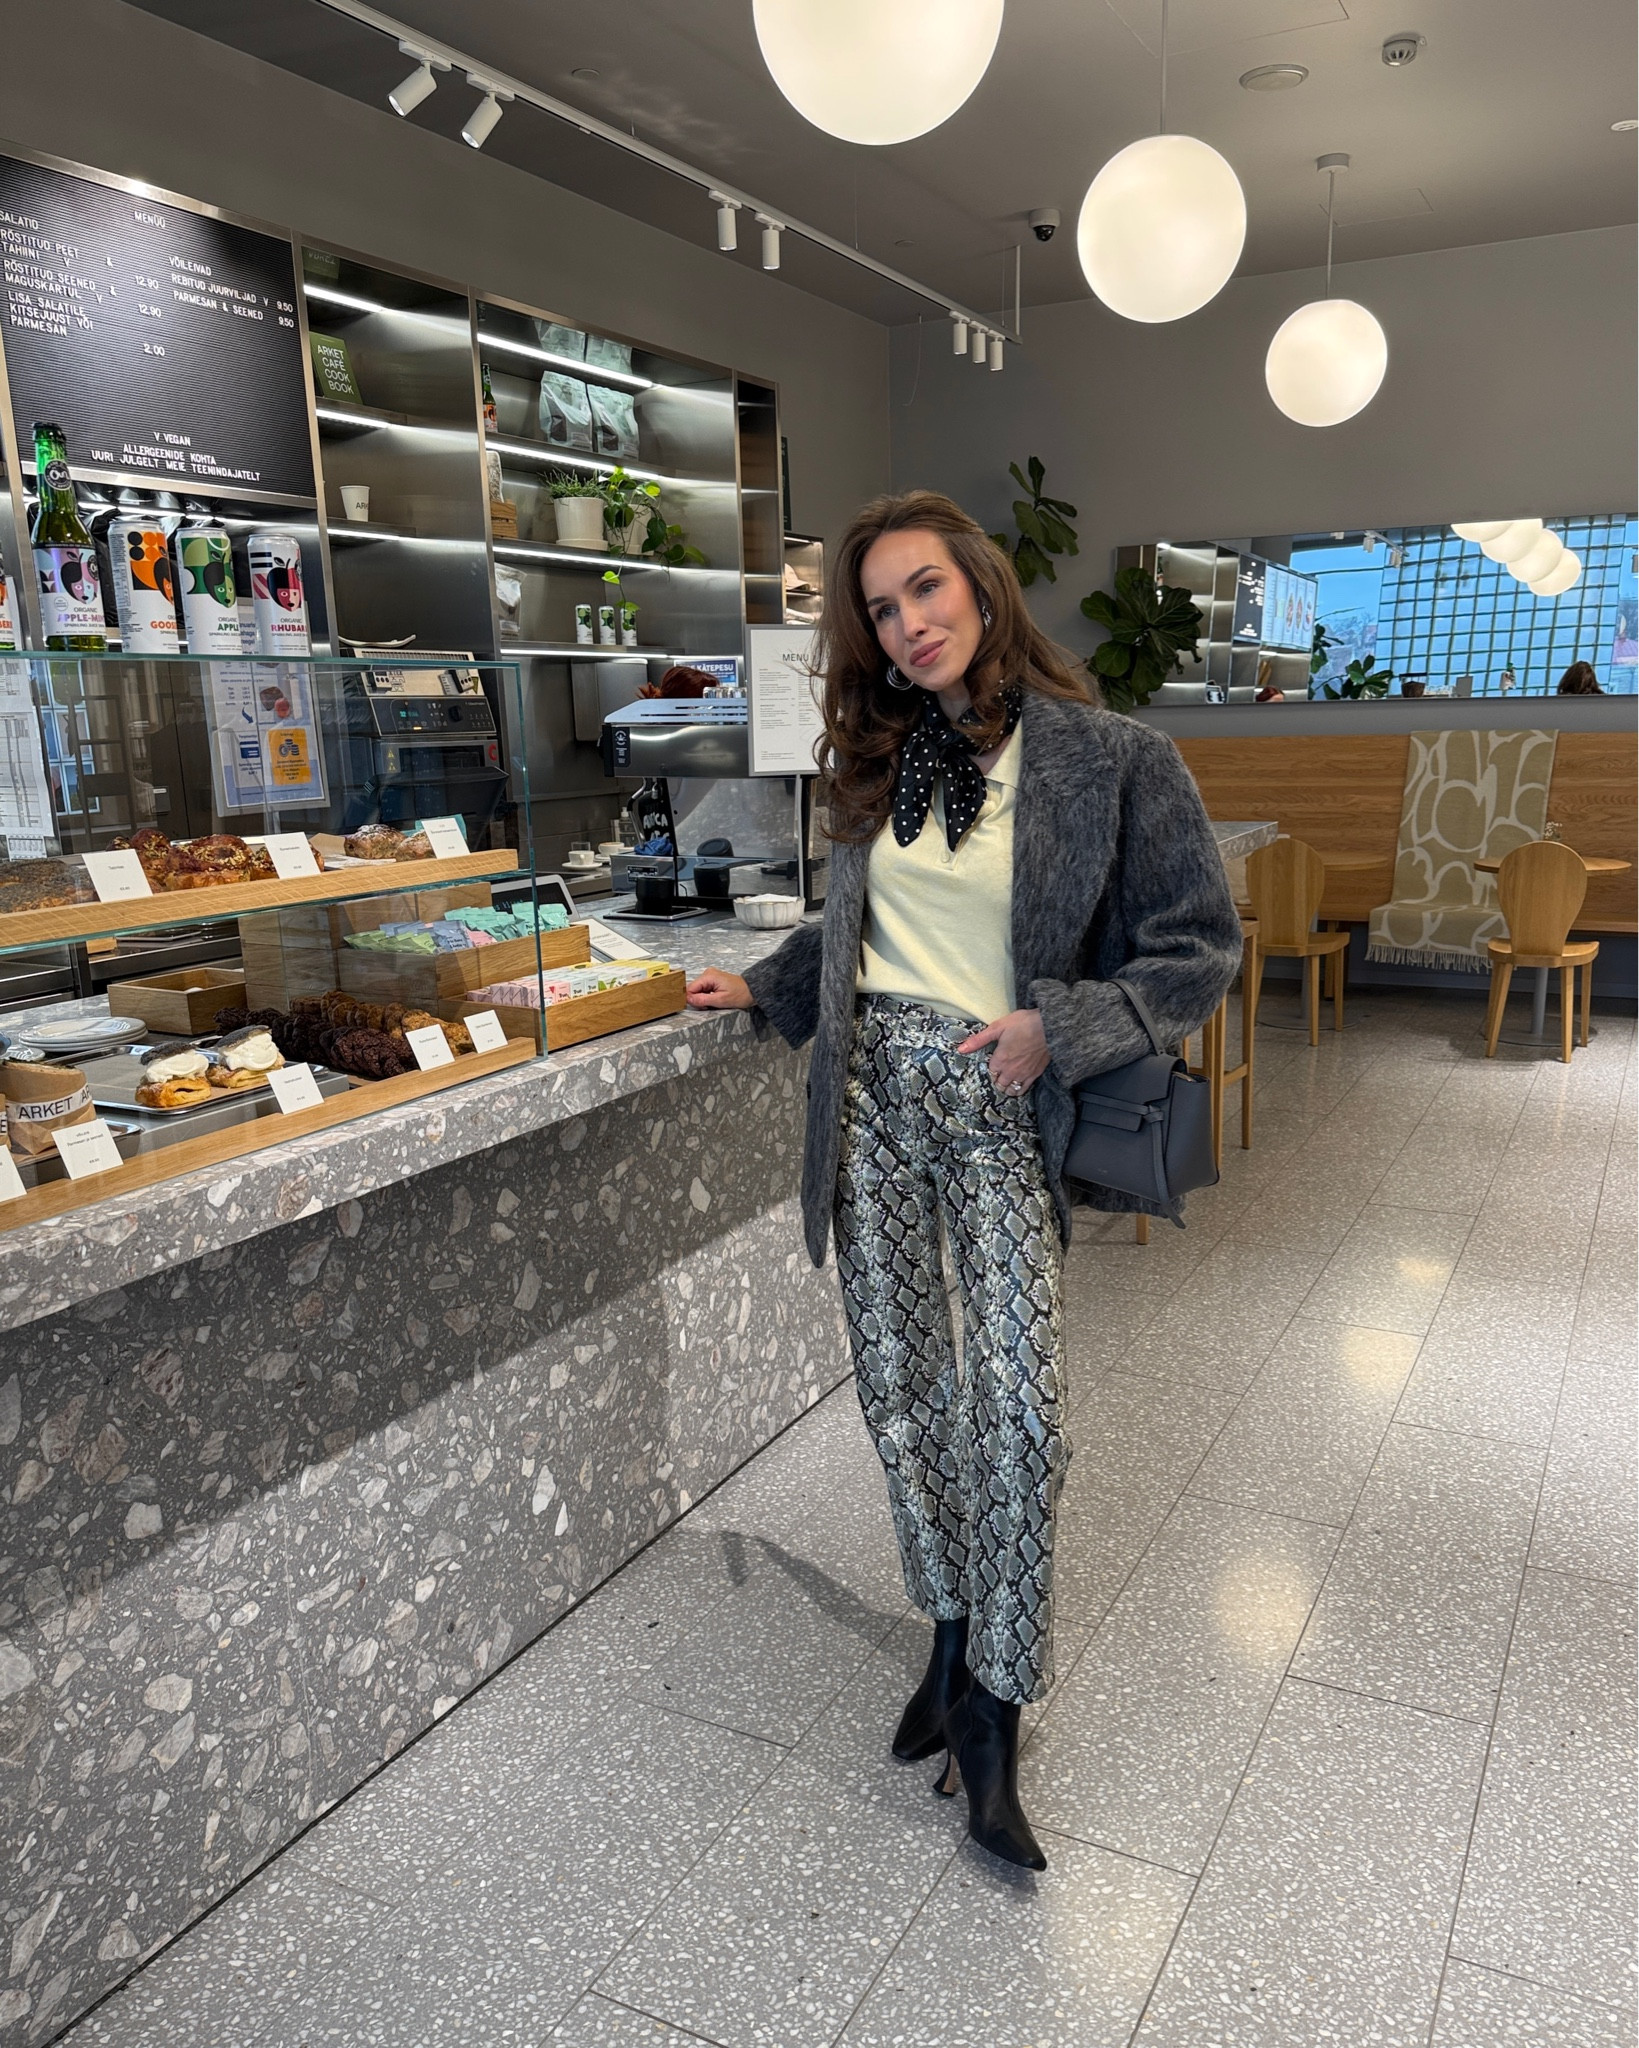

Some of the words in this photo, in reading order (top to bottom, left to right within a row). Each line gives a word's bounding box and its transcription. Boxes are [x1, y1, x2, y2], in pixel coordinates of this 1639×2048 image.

[55, 243, 78, 259] PEET
[106, 257, 113, 267] &
[57, 273, 96, 291] SEENED
[110, 286, 117, 296] &
[64, 257, 70, 267] V
[136, 276, 159, 289] 12.90
[5, 272, 81, 299] MAGUSKARTUL
[96, 293, 102, 304] V
[138, 303, 162, 318] 12.90
[171, 273, 206, 291] REBITUD
[208, 283, 257, 304] JUURVILJAD
[263, 297, 269, 307] V
[8, 291, 32, 305] LISA
[38, 297, 85, 317] SALATILE
[173, 290, 218, 310] PARMESAN
[222, 302, 229, 312] &
[232, 305, 264, 321] SEENED
[10, 303, 71, 326] KITSEJUUST
[77, 316, 93, 330] VÕI
[11, 315, 67, 337] PARMESAN
[143, 343, 166, 357] 2.00
[317, 344, 344, 360] ARKET
[322, 357, 346, 371] CAFÉ
[324, 368, 351, 383] COOK
[328, 380, 355, 395] BOOK
[153, 432, 160, 441] V
[163, 433, 191, 446] VEGAN
[91, 450, 114, 462] UURI
[120, 454, 159, 469] JULGELT
[165, 460, 187, 472] MEIE
[191, 463, 261, 482] TEENINDAJATELT
[123, 444, 186, 462] ALLERGEENIDE
[190, 452, 217, 466] KOHTA
[782, 653, 809, 662] MENU
[18, 1096, 73, 1119] ARKET
